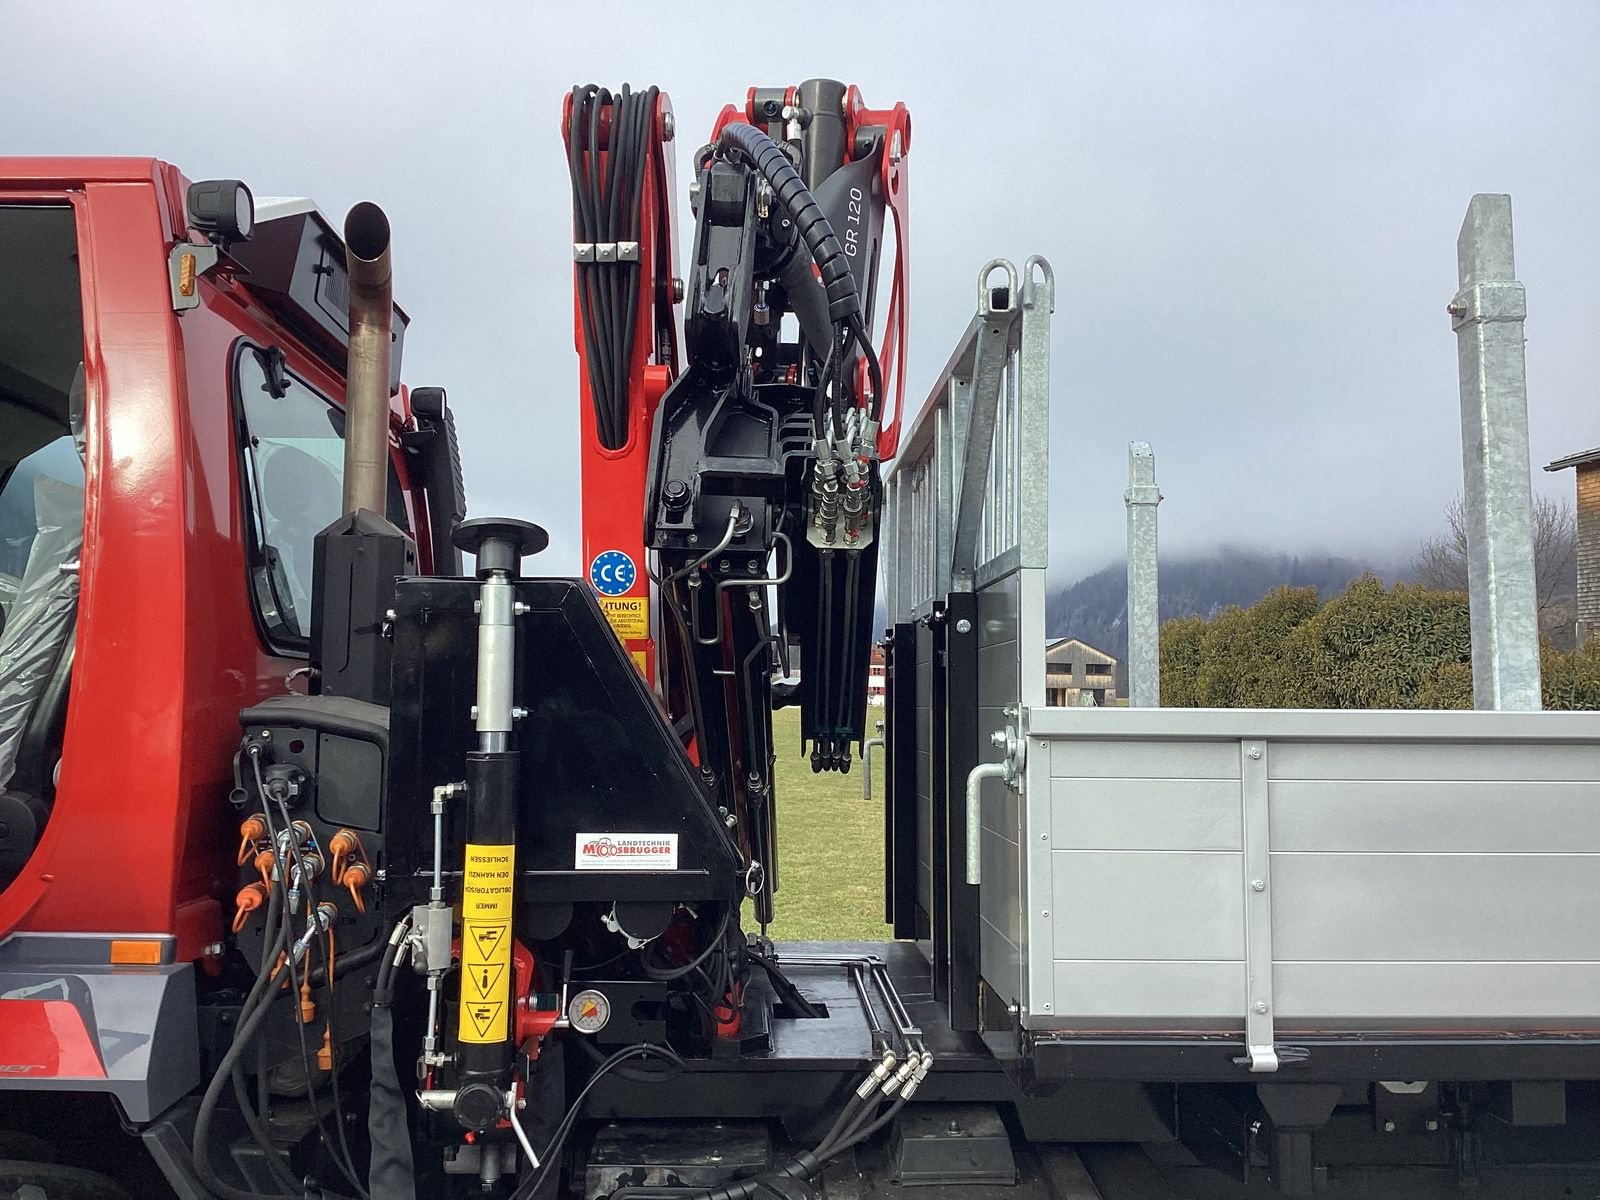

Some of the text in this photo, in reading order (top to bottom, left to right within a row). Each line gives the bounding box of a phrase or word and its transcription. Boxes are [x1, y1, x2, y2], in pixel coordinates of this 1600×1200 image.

[844, 187, 862, 257] GR 120
[600, 564, 626, 582] CE
[470, 855, 509, 863] SCHLIESSEN
